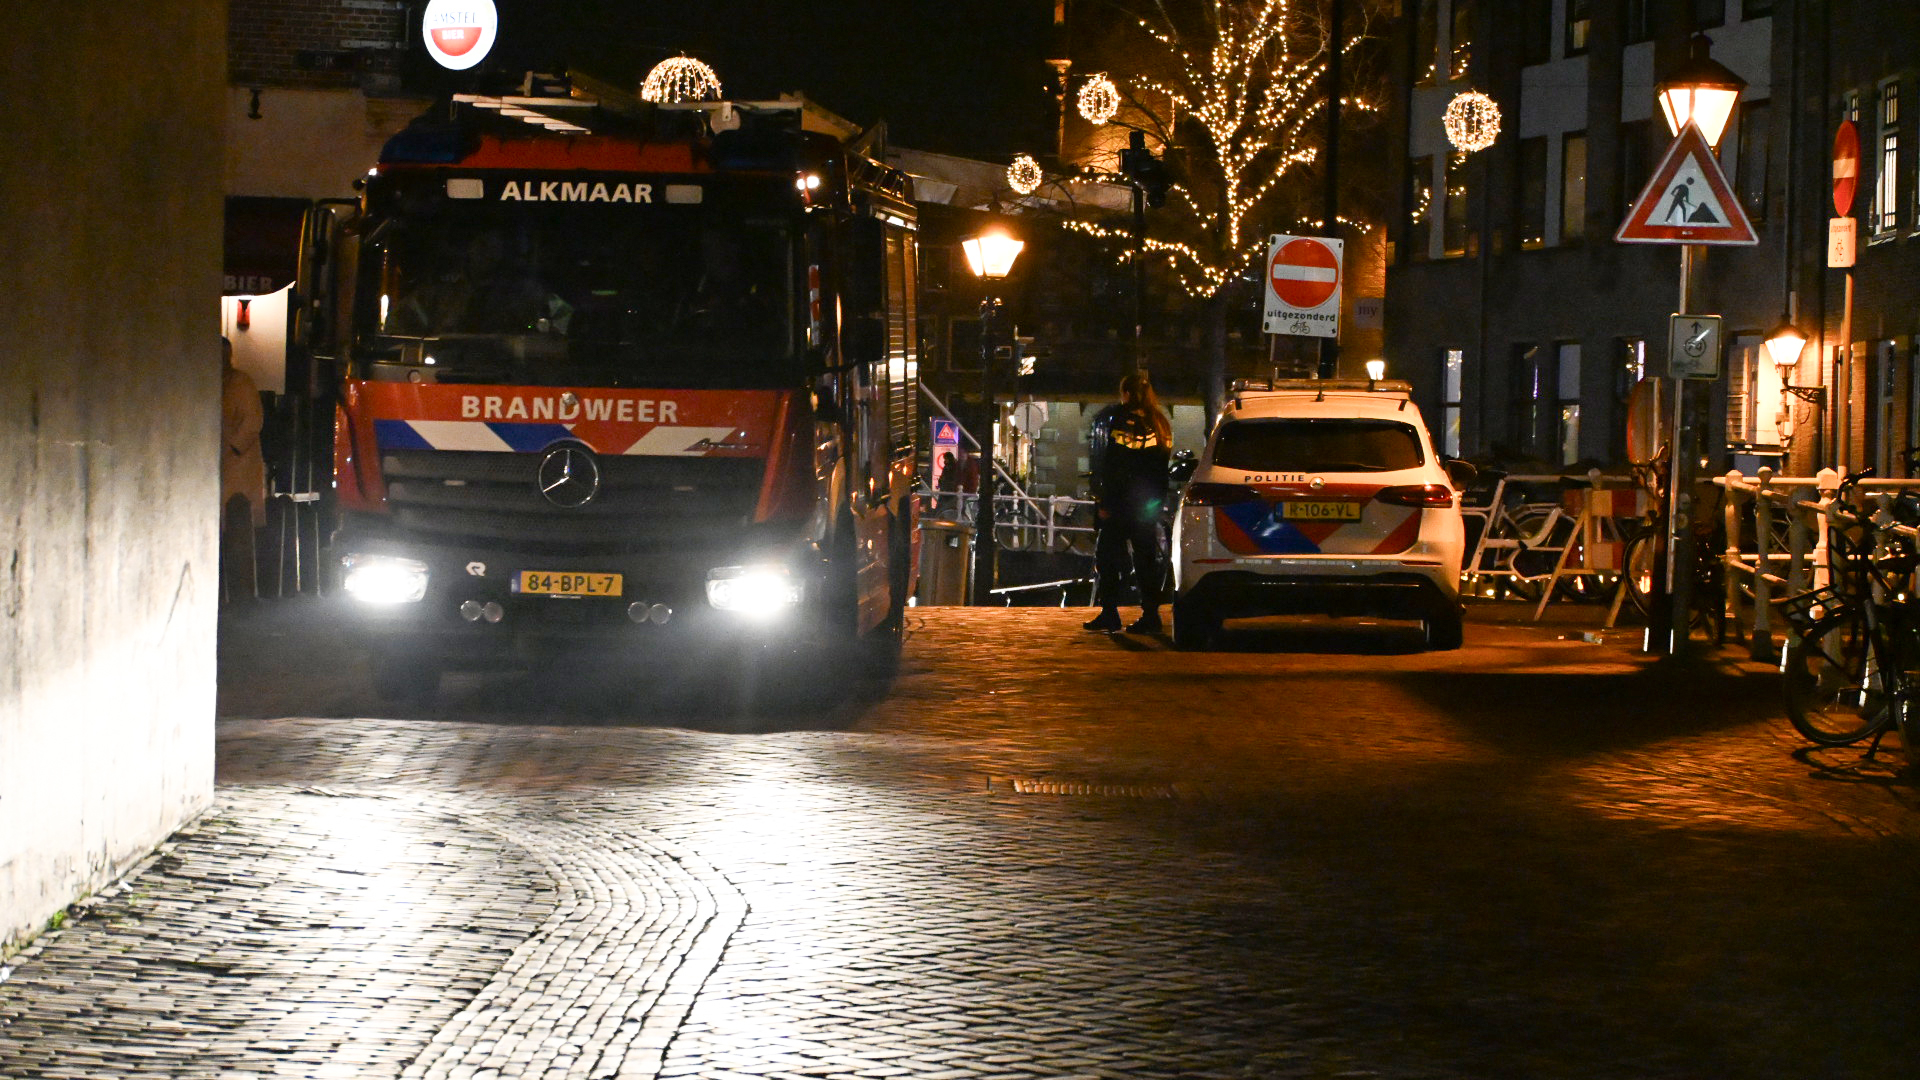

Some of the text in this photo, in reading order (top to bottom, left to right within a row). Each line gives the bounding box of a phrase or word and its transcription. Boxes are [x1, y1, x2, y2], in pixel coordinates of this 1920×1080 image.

[433, 11, 478, 24] AMSTEL
[500, 180, 653, 203] ALKMAAR
[223, 275, 272, 291] BIER
[1267, 309, 1336, 322] uitgezonderd
[461, 395, 678, 423] BRANDWEER
[1244, 474, 1305, 483] POLITIE
[1289, 503, 1355, 518] R-106-VL
[527, 574, 615, 594] 84-BPL-7
